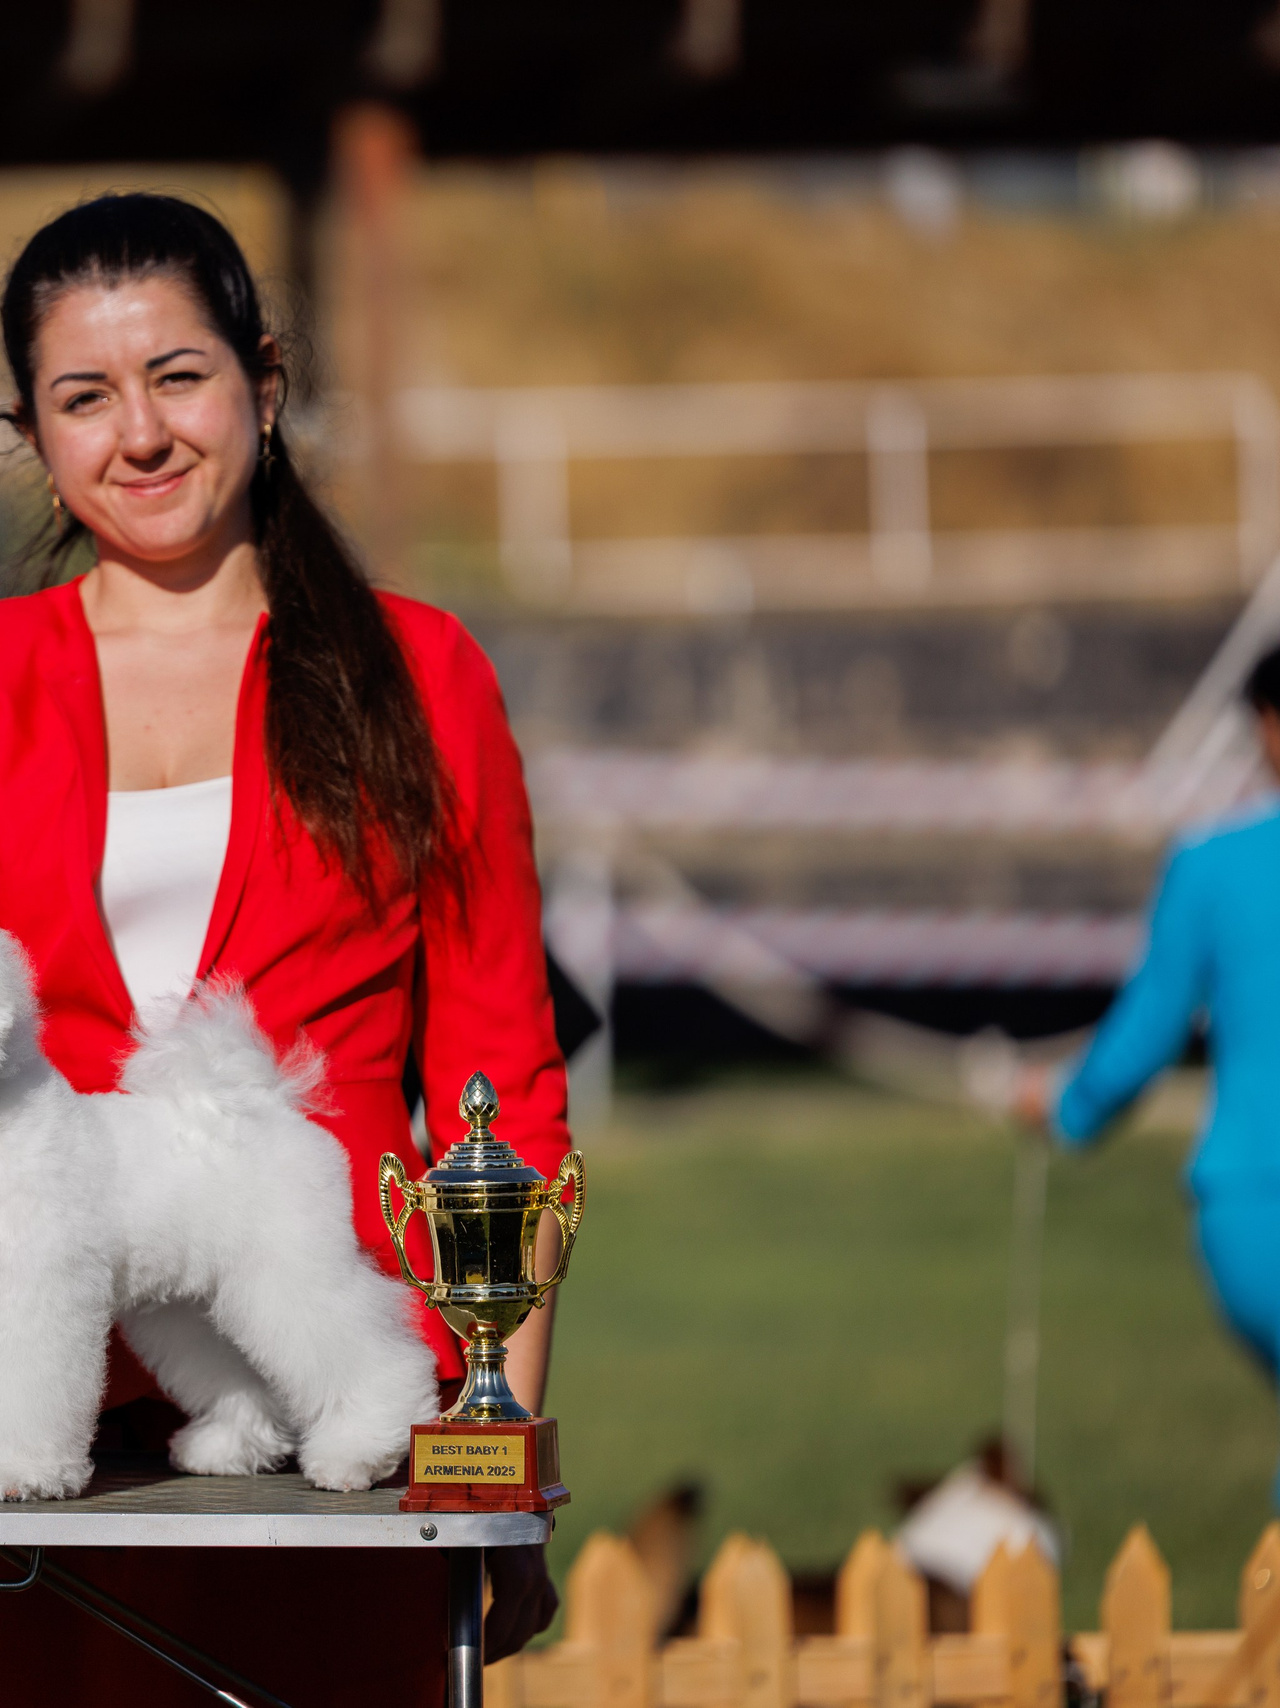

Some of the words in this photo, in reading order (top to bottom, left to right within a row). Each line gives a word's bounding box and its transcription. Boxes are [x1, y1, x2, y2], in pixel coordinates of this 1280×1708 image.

[432, 1445, 463, 1455] BEST
[466, 1445, 499, 1455] BABY
[502, 1446, 508, 1456] 1
[424, 1465, 484, 1476] ARMENIA
[487, 1465, 516, 1476] 2025
